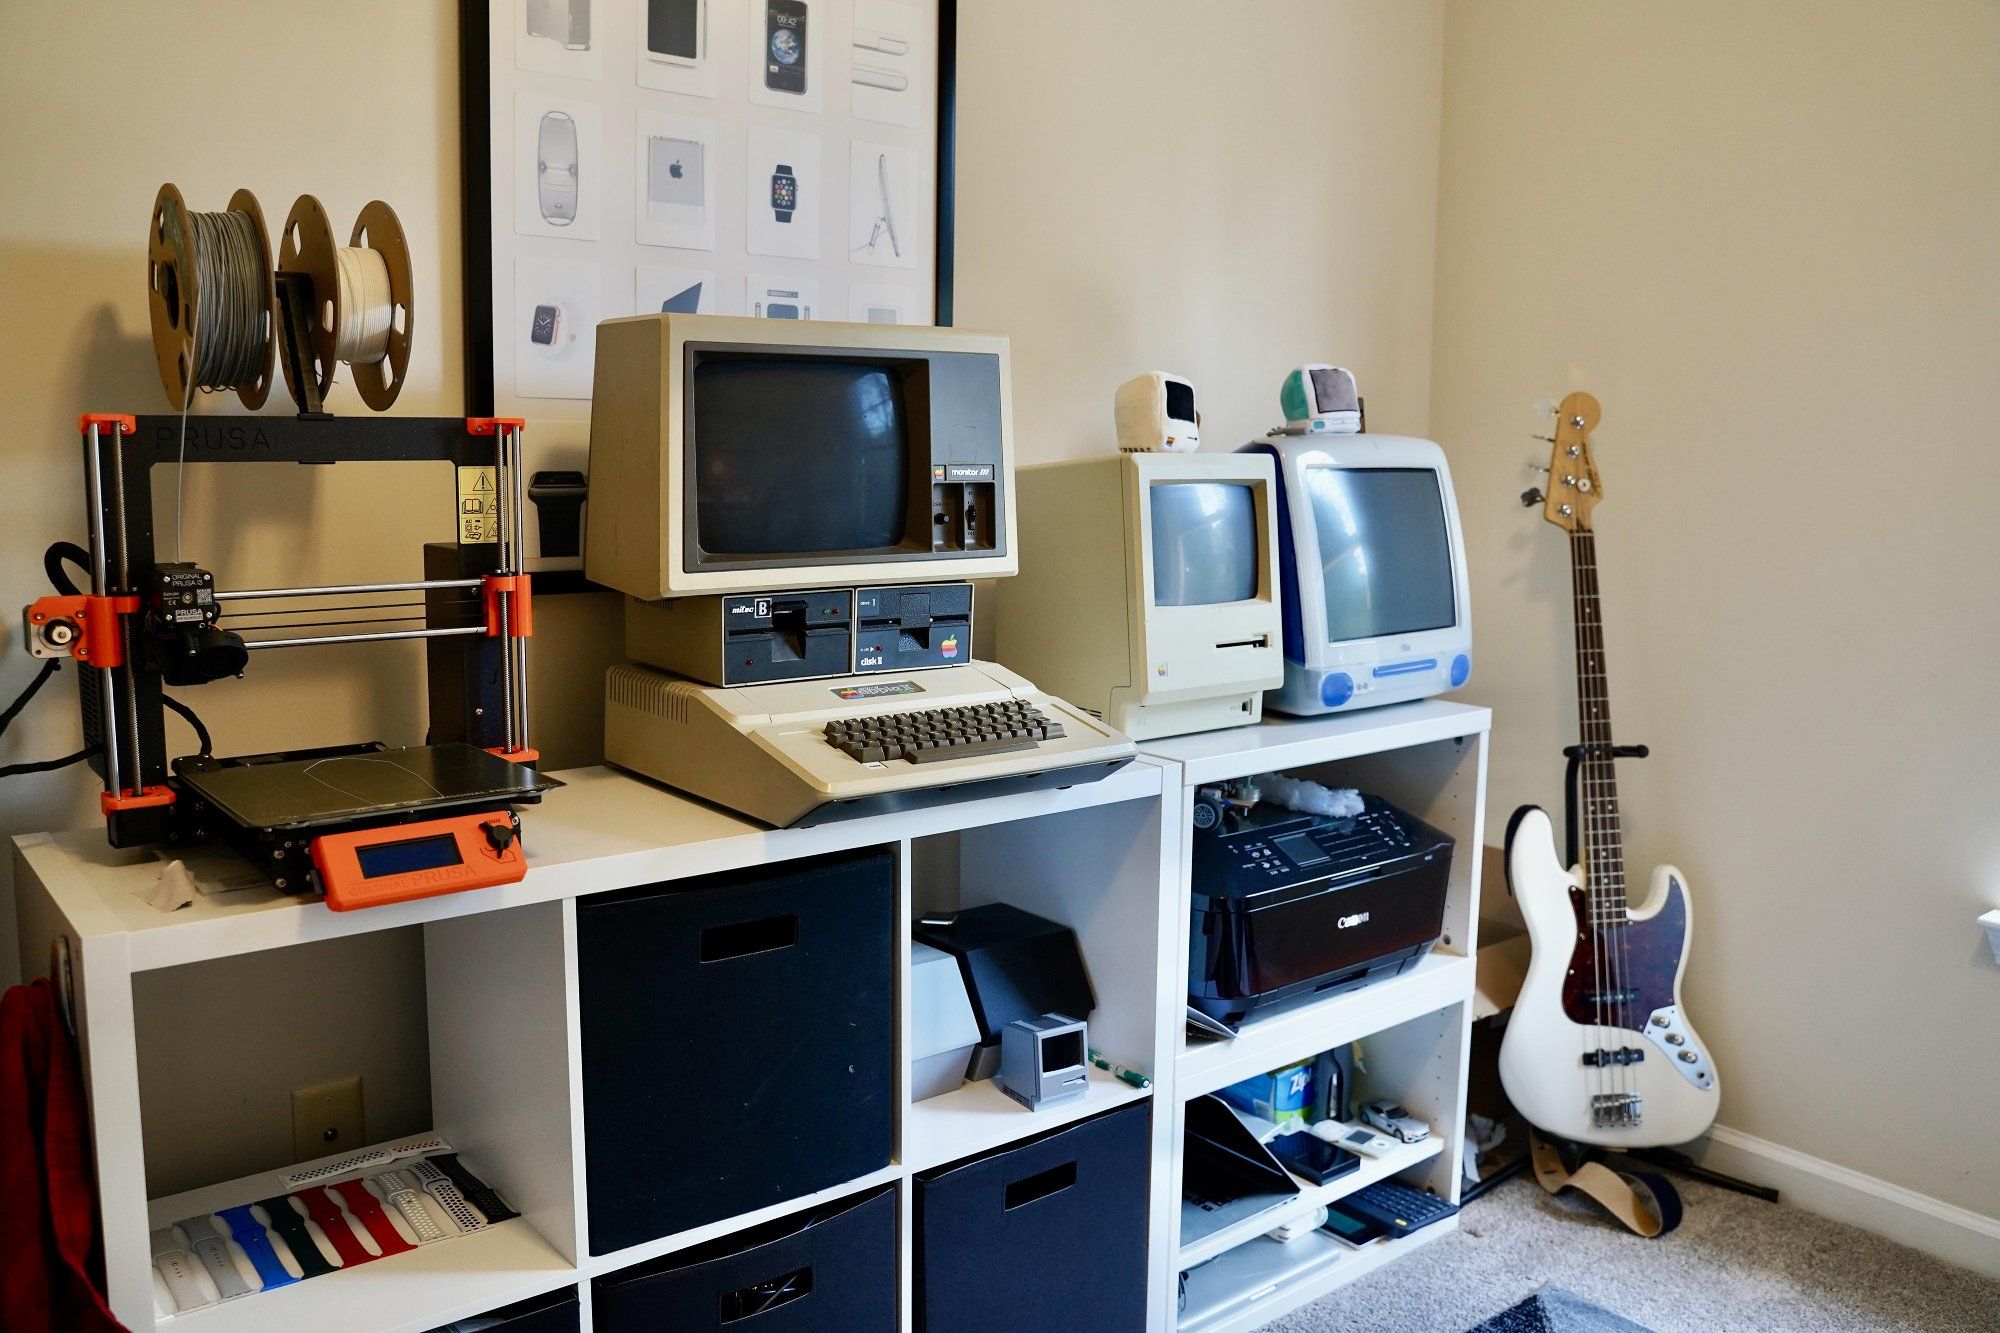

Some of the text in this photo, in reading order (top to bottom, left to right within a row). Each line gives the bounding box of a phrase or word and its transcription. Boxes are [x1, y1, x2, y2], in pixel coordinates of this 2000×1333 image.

[777, 15, 797, 26] 09:42
[156, 426, 271, 450] PRUSA
[860, 656, 877, 666] disk
[348, 865, 478, 897] ORIGINAL PRUSA
[1337, 911, 1370, 929] Caon
